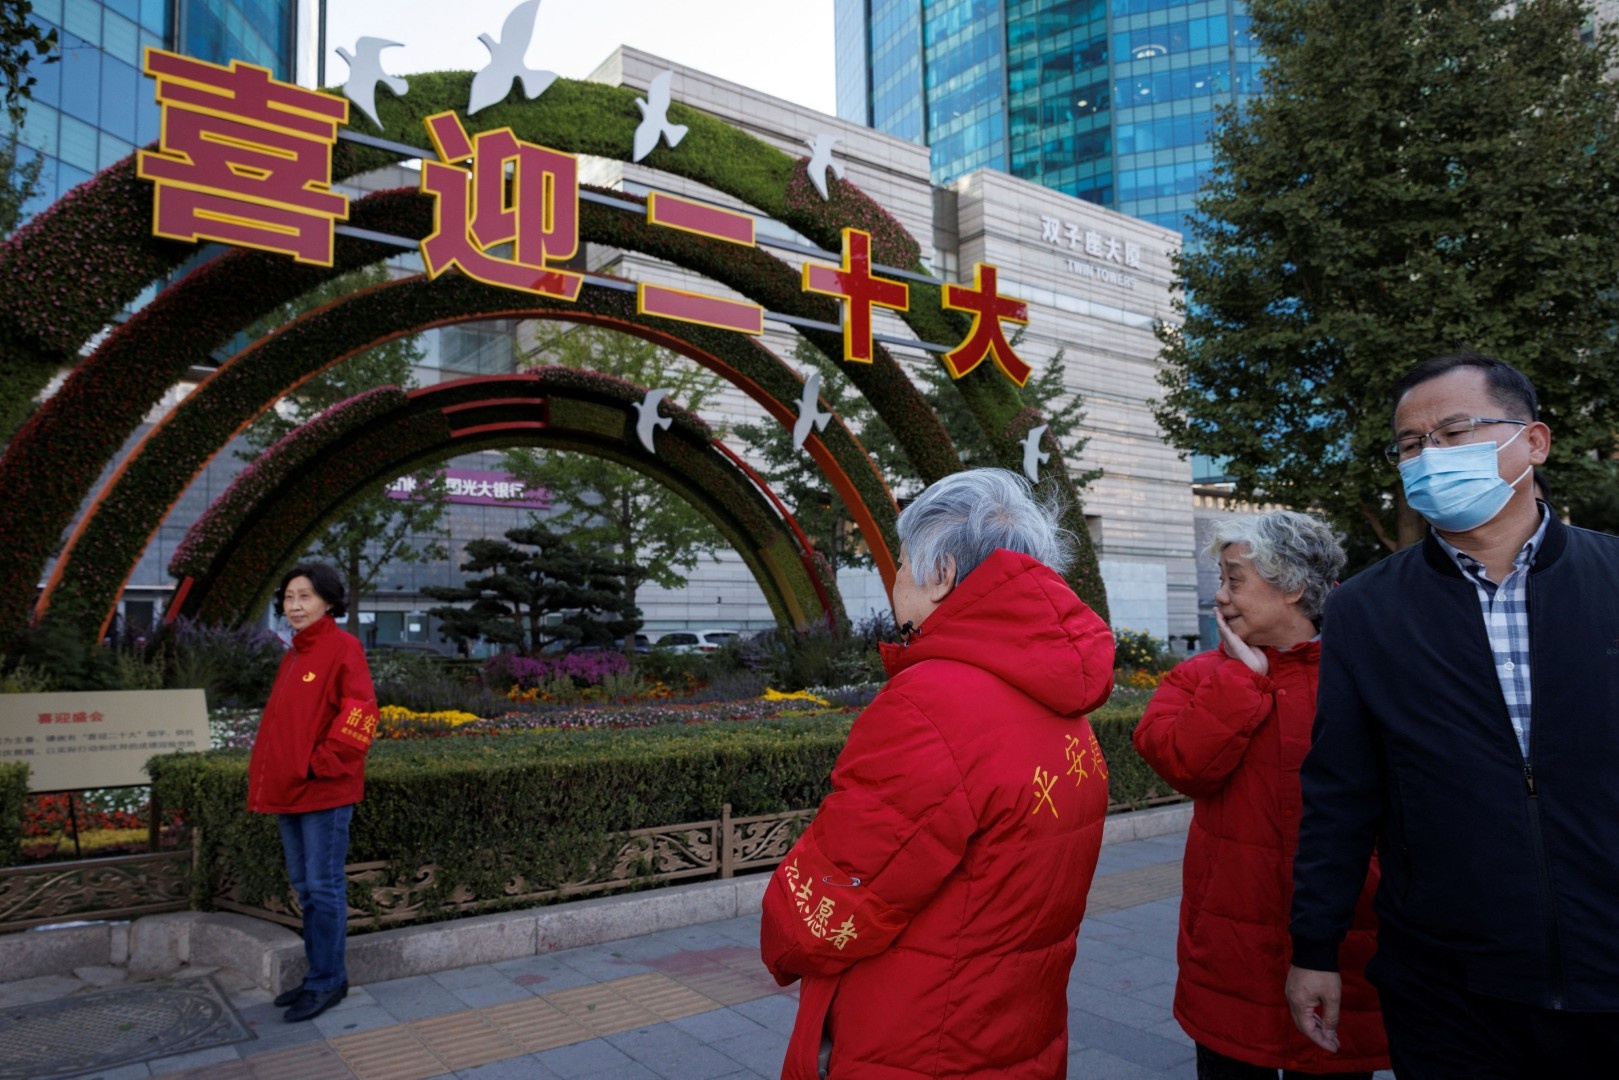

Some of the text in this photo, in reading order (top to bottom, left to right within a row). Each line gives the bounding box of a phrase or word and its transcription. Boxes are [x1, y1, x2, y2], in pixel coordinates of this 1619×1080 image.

[136, 45, 1032, 388] 喜迎二十大
[1041, 216, 1141, 269] 双子座大厦
[1066, 260, 1136, 290] TWIN TOWERS
[429, 477, 525, 498] 国光大银行
[37, 711, 105, 725] 喜迎盛会
